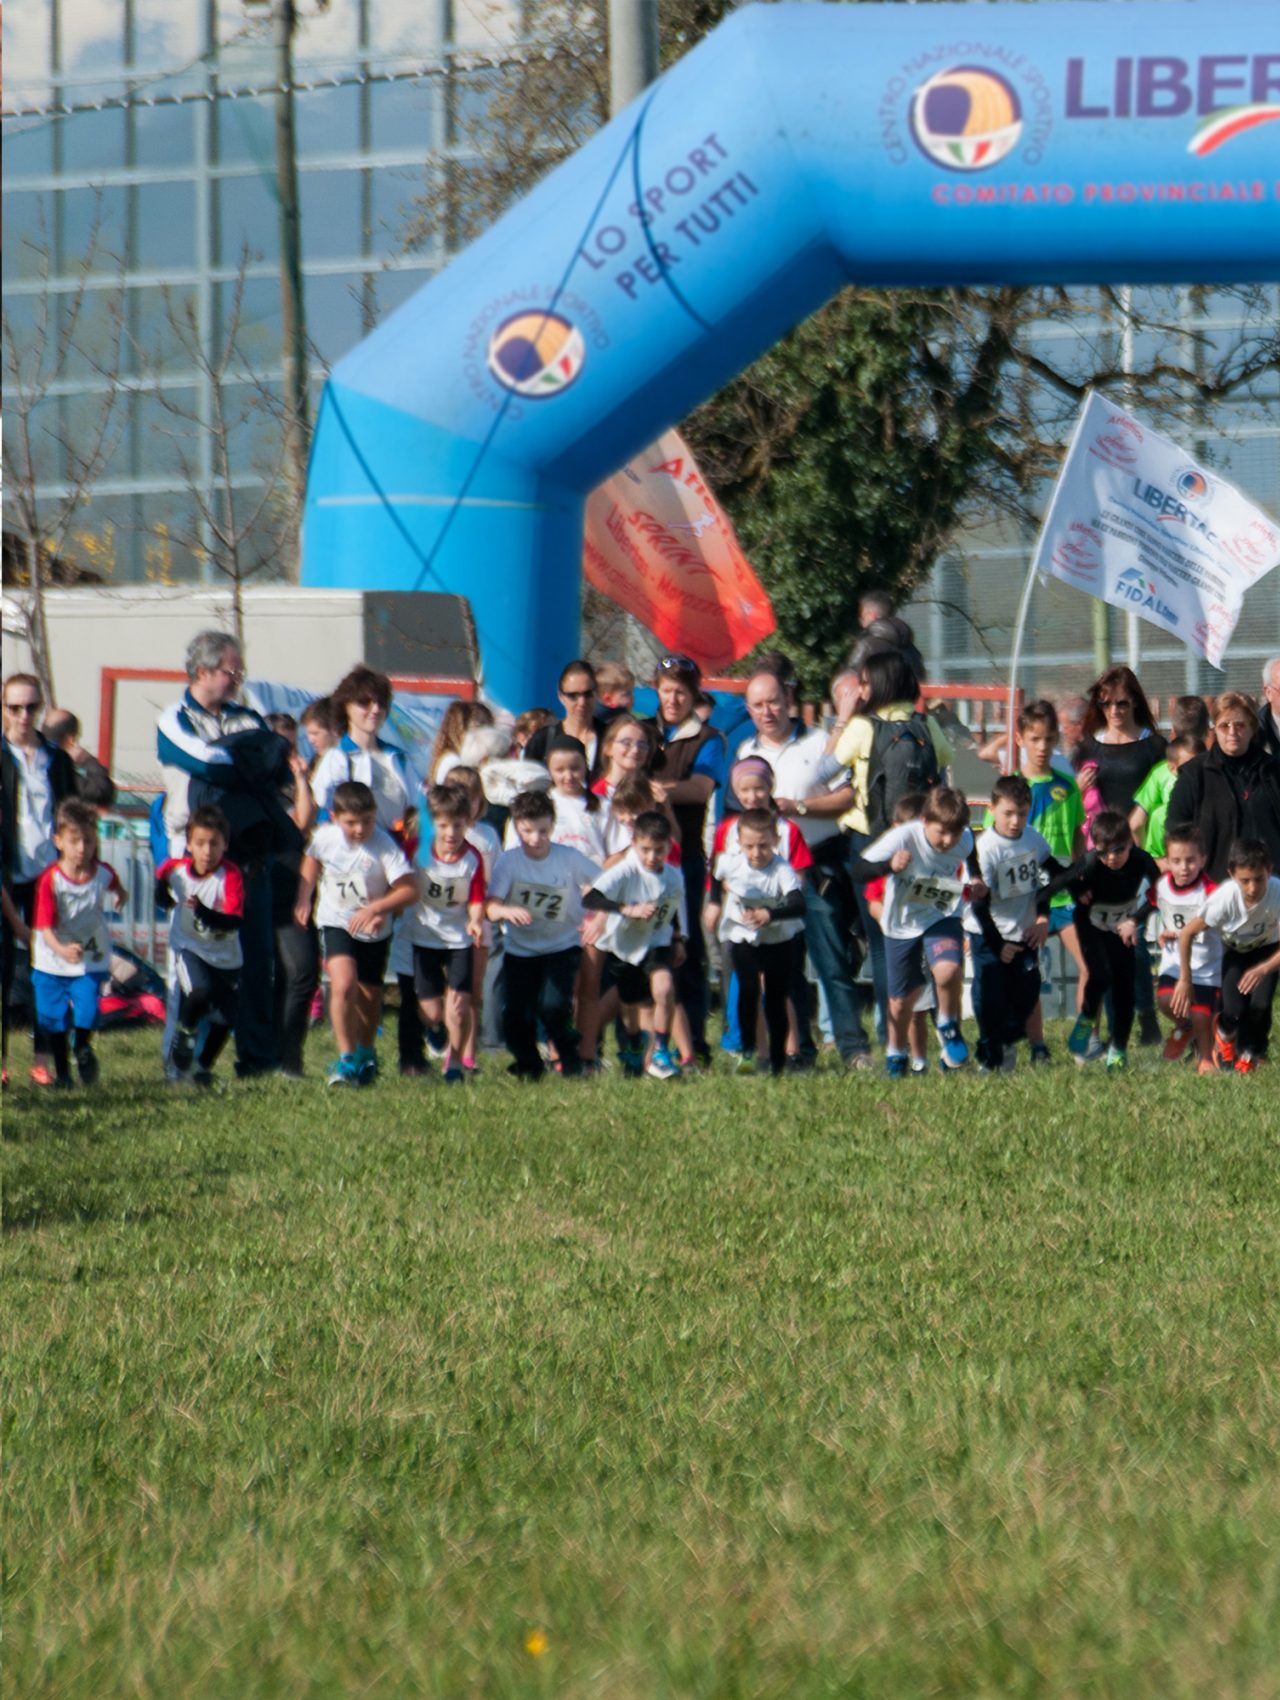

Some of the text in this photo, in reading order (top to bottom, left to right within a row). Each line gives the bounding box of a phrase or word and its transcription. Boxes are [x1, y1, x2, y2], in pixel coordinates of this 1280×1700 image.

[879, 41, 1053, 165] CENTRO NAZIONALE SPORTIVO
[579, 132, 730, 273] LO SPORT
[932, 183, 1074, 206] COMITATO
[1085, 181, 1264, 204] PROVINCIALE
[614, 170, 760, 301] PER TUTTI
[1006, 859, 1037, 885] 183
[337, 880, 358, 899] 71
[428, 882, 455, 901] 81
[520, 889, 563, 910] 172
[912, 884, 954, 903] 159
